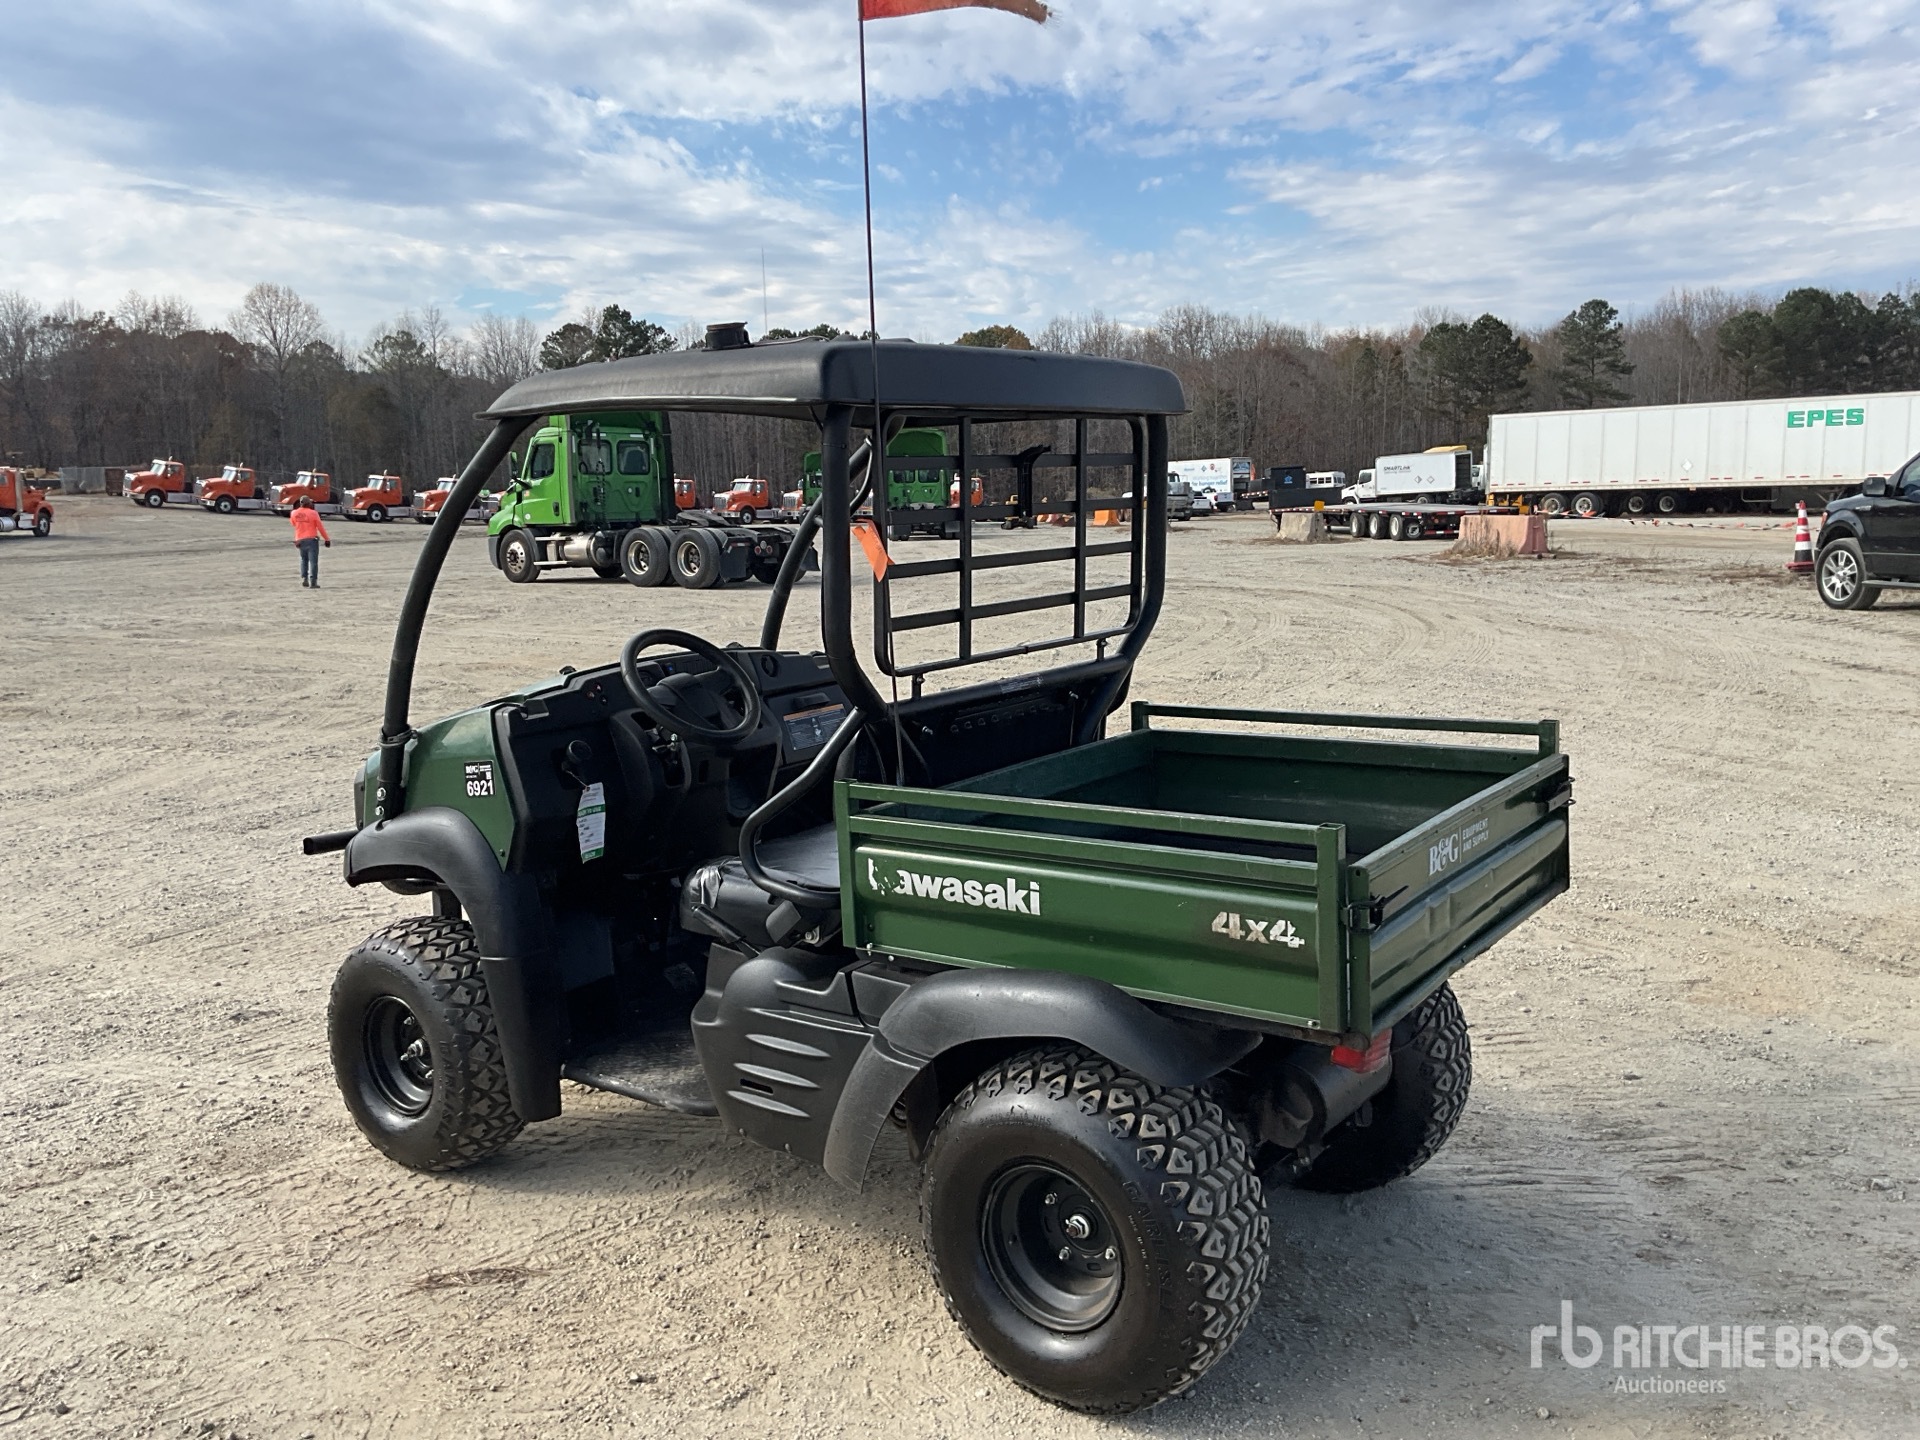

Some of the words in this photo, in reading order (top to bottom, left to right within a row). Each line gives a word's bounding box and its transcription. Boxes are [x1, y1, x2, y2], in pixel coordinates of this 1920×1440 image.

[1787, 408, 1865, 428] EPES
[466, 779, 494, 797] 6921
[1462, 817, 1489, 840] EQUIPMENT
[1472, 829, 1489, 847] SUPPLY
